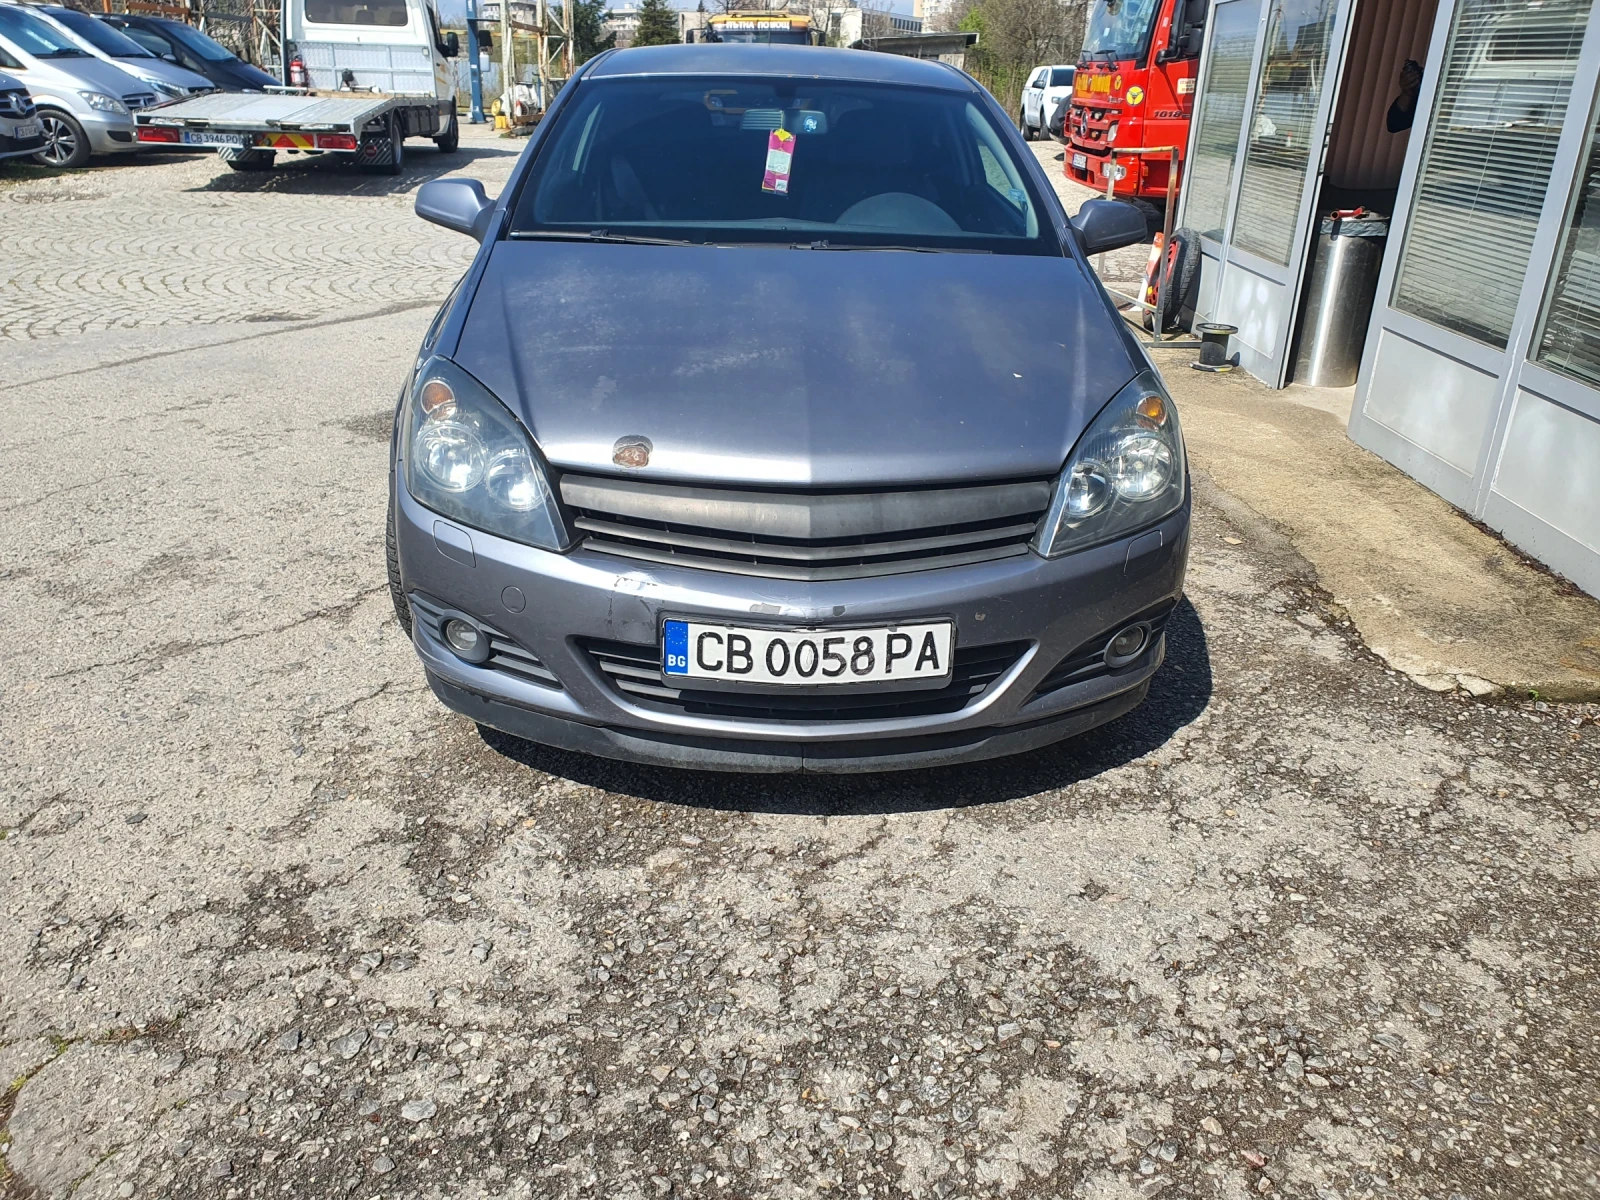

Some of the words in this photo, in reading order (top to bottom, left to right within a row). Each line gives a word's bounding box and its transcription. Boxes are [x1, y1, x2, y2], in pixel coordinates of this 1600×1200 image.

[757, 21, 790, 31] ПОМОЩ
[1154, 110, 1182, 118] 1018
[190, 133, 203, 143] CB
[203, 134, 225, 143] 3946
[696, 631, 754, 674] CB
[765, 635, 876, 678] 0058
[885, 631, 940, 674] PA
[667, 655, 687, 668] BG
